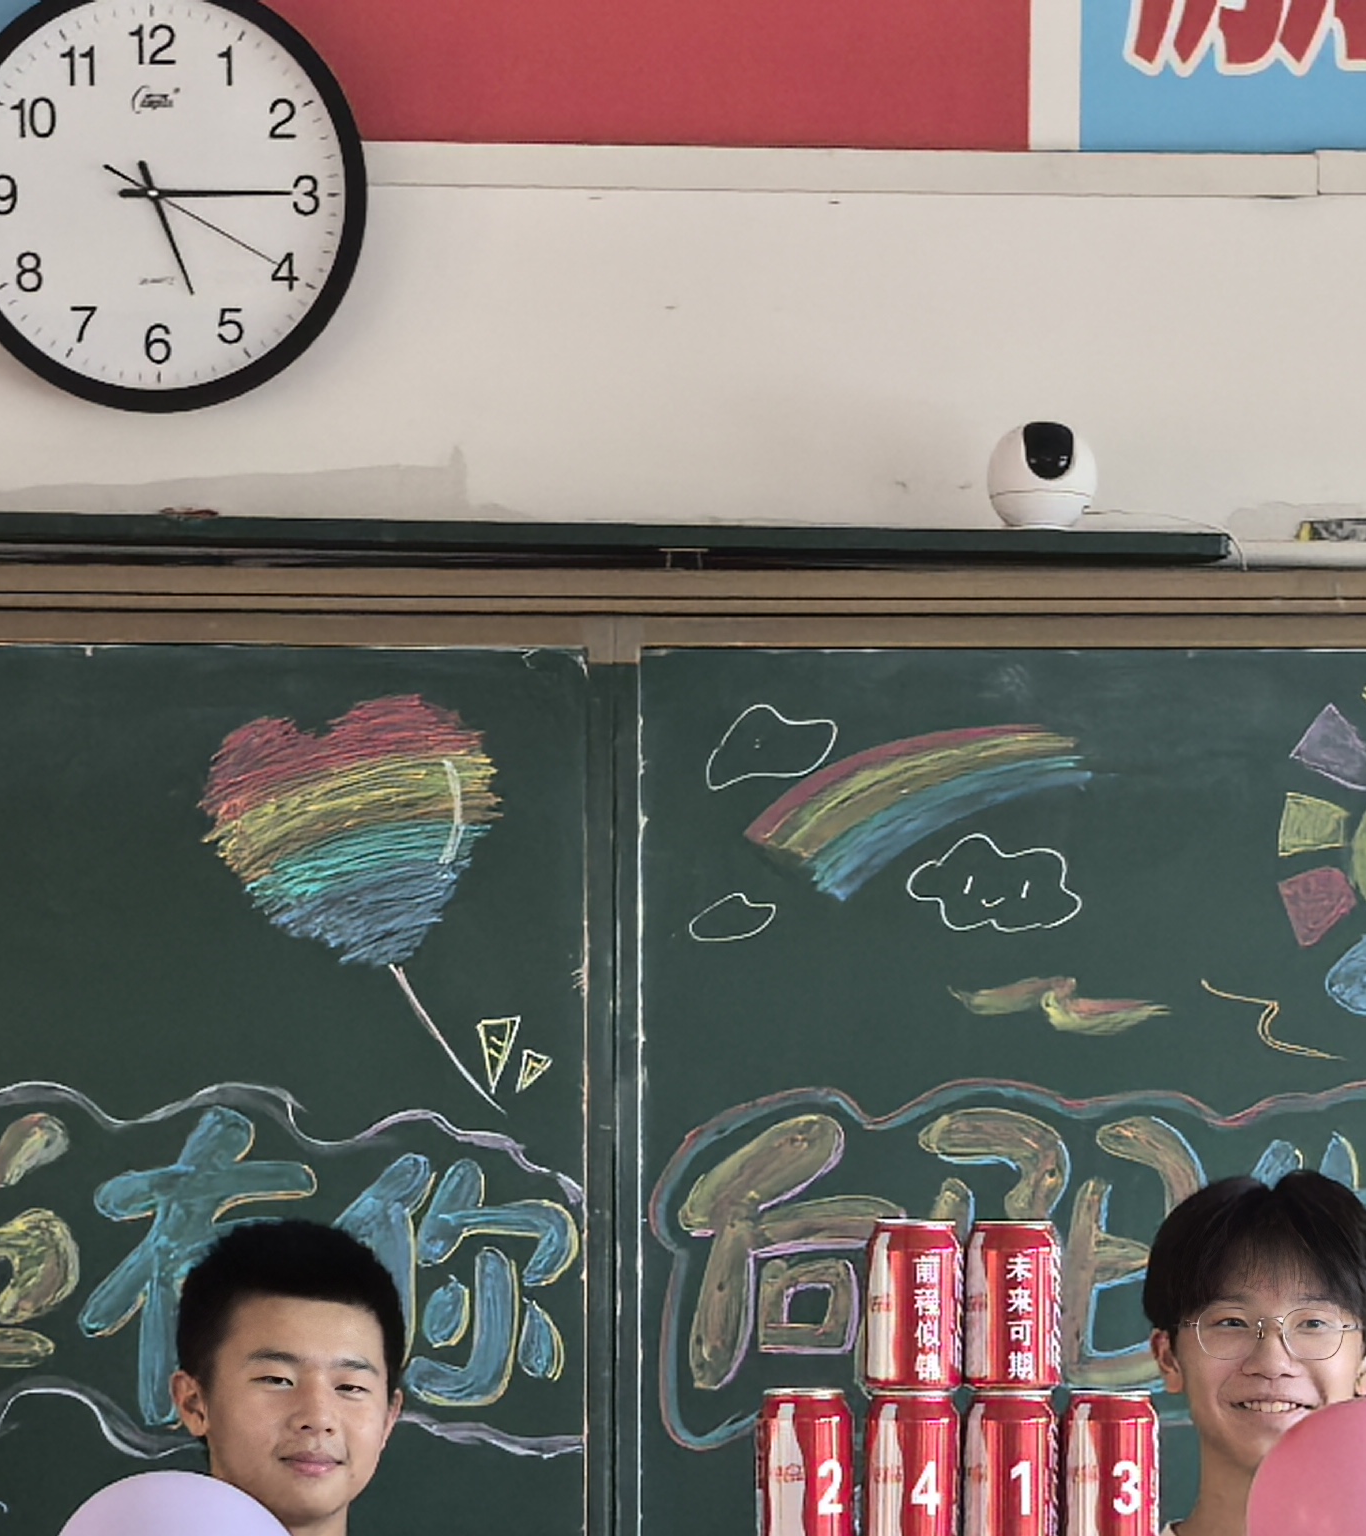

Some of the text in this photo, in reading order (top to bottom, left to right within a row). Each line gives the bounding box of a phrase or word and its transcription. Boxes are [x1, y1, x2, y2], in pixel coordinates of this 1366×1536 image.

[129, 24, 176, 66] 12
[60, 45, 96, 87] 11
[218, 45, 234, 87] 1
[10, 97, 57, 138] 10
[268, 98, 297, 139] 2
[292, 175, 321, 216] 3
[16, 252, 43, 293] 8
[271, 252, 300, 291] 4
[70, 306, 98, 343] 7
[144, 323, 171, 364] 6
[217, 307, 244, 344] 5
[913, 1254, 941, 1382] 前程似锦
[1005, 1254, 1034, 1382] 未来可期
